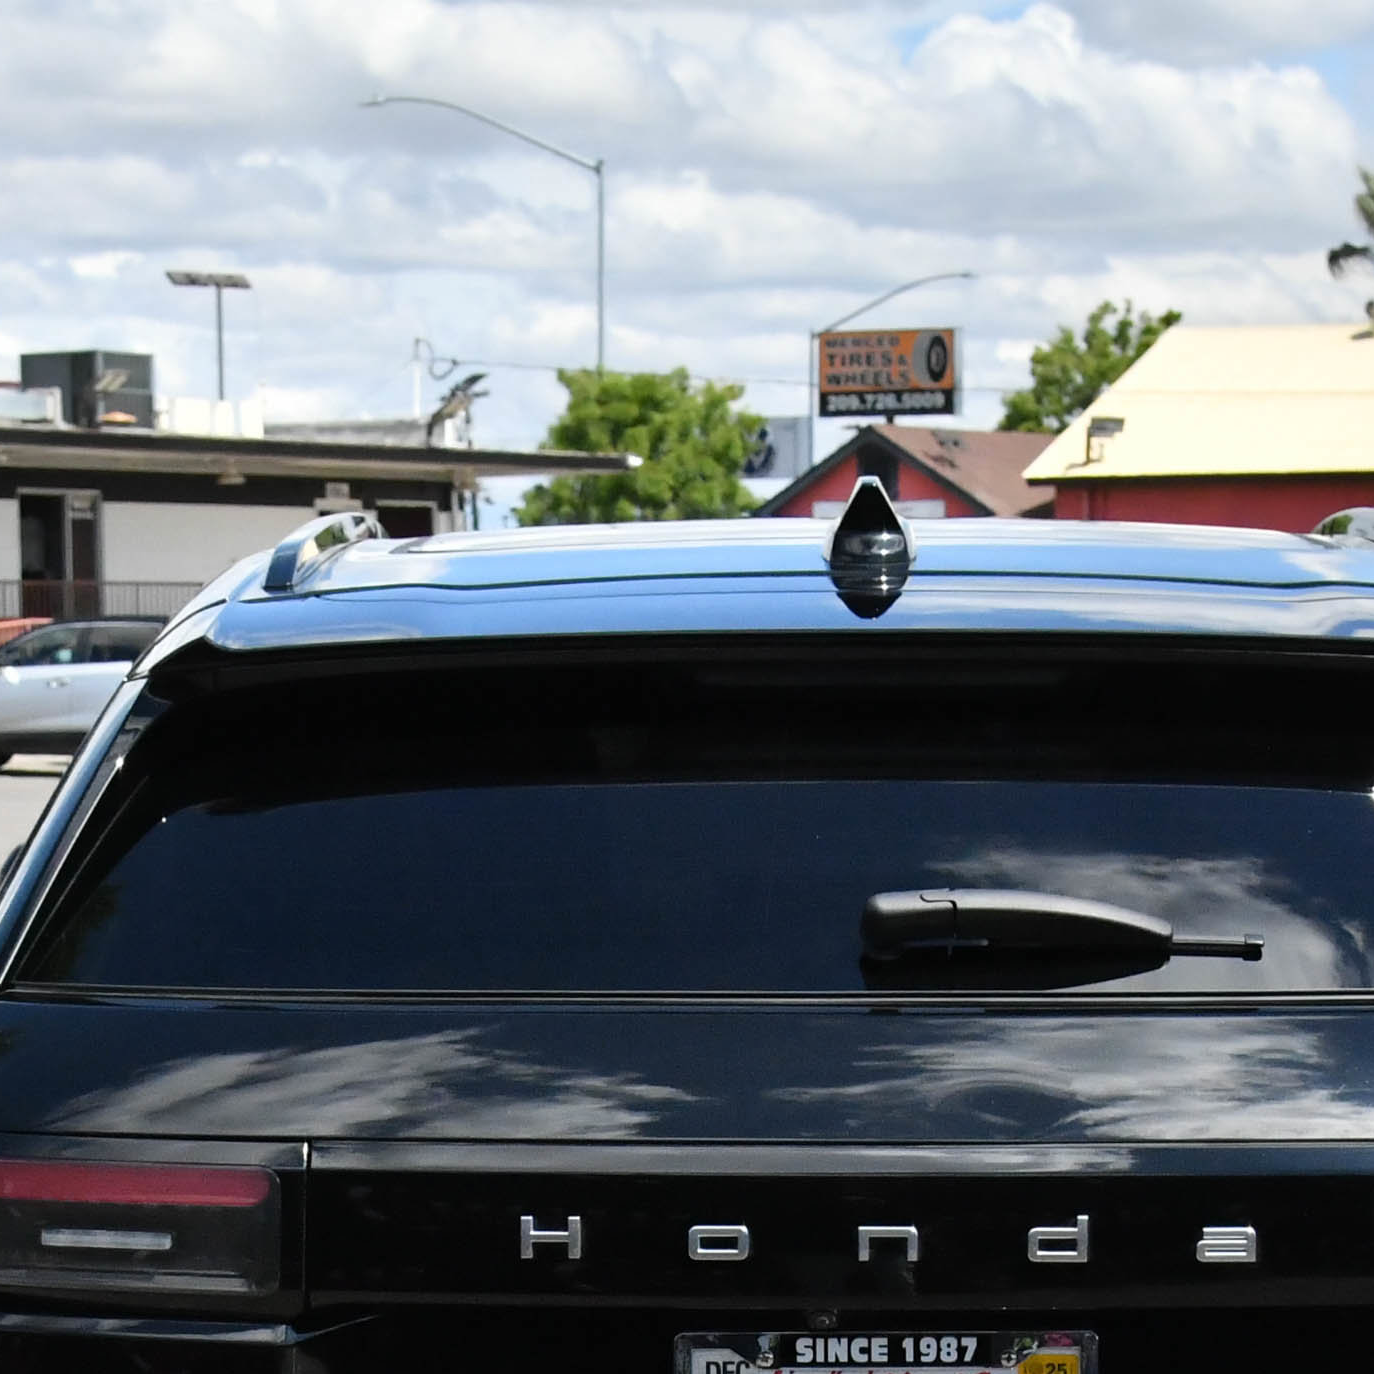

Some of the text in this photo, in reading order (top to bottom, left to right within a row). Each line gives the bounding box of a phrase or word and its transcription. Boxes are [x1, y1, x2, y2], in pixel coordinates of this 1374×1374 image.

[827, 352, 893, 368] TIRES
[826, 371, 910, 387] WHEELS
[796, 1336, 978, 1363] SINCE 1987
